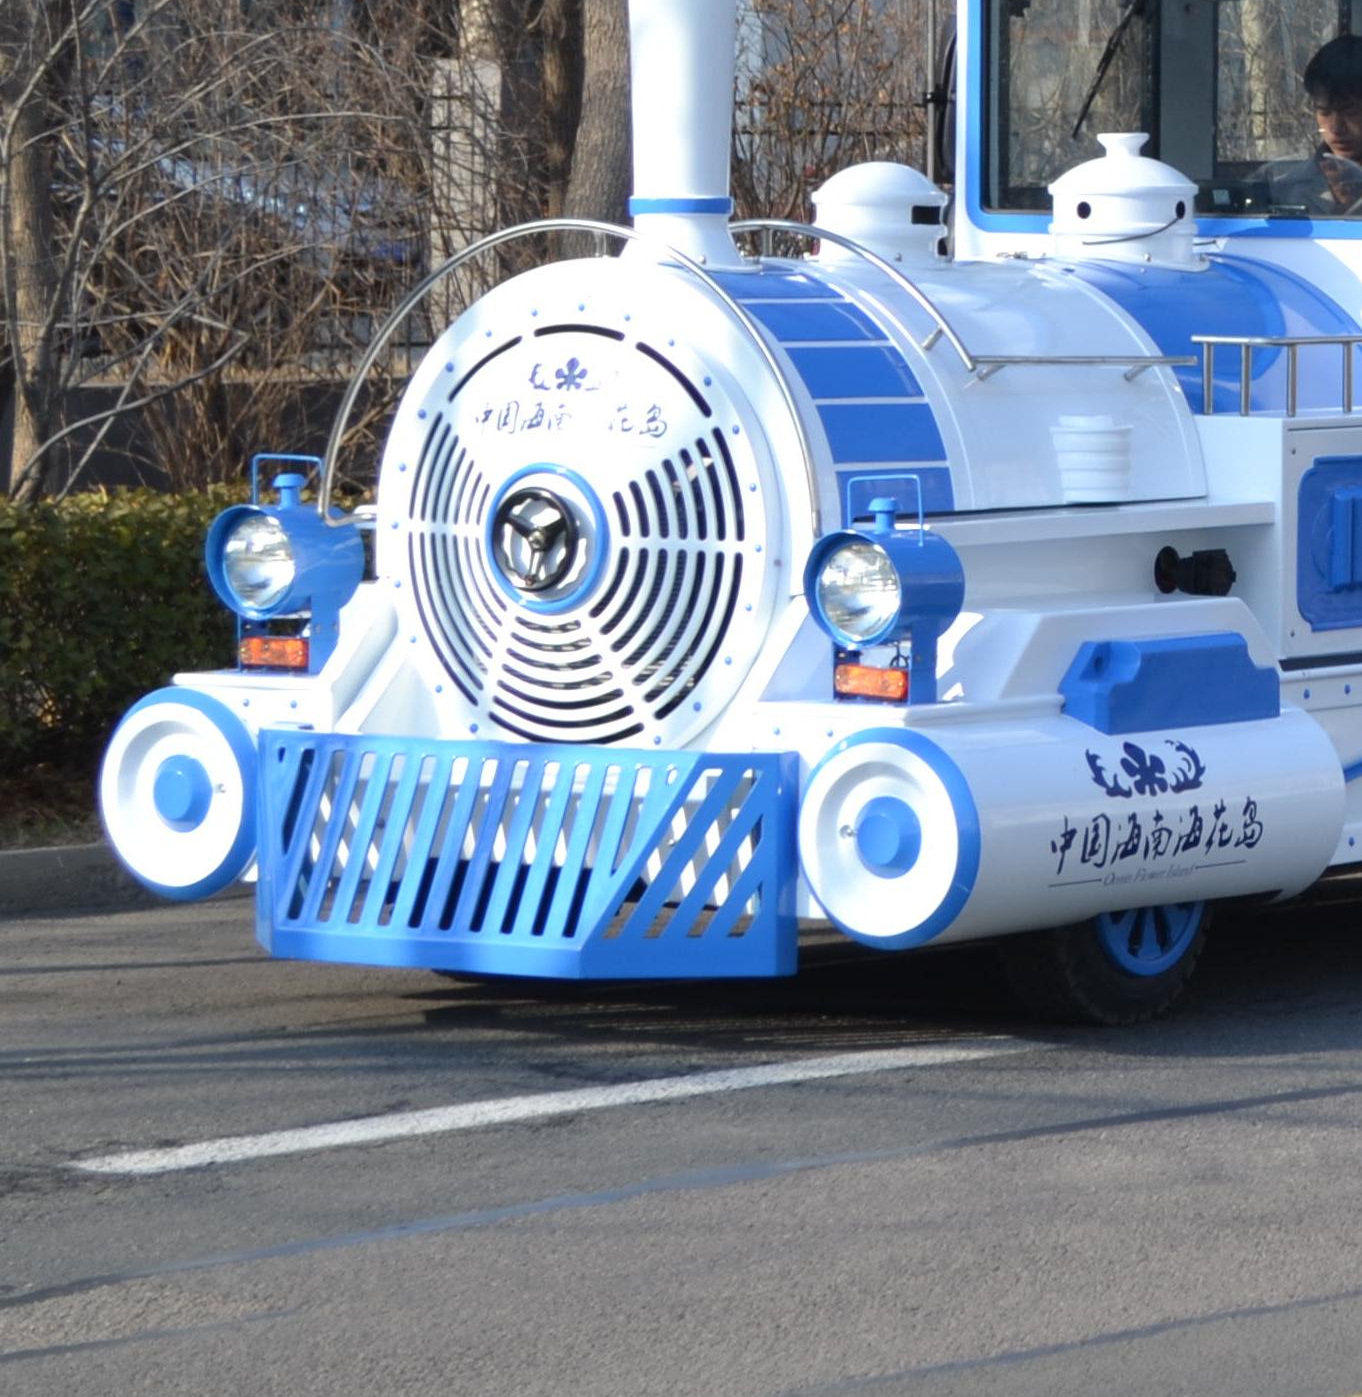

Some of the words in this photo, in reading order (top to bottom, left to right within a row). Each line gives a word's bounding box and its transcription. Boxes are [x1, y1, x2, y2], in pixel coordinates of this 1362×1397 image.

[1050, 796, 1264, 875] 中国海南海花岛
